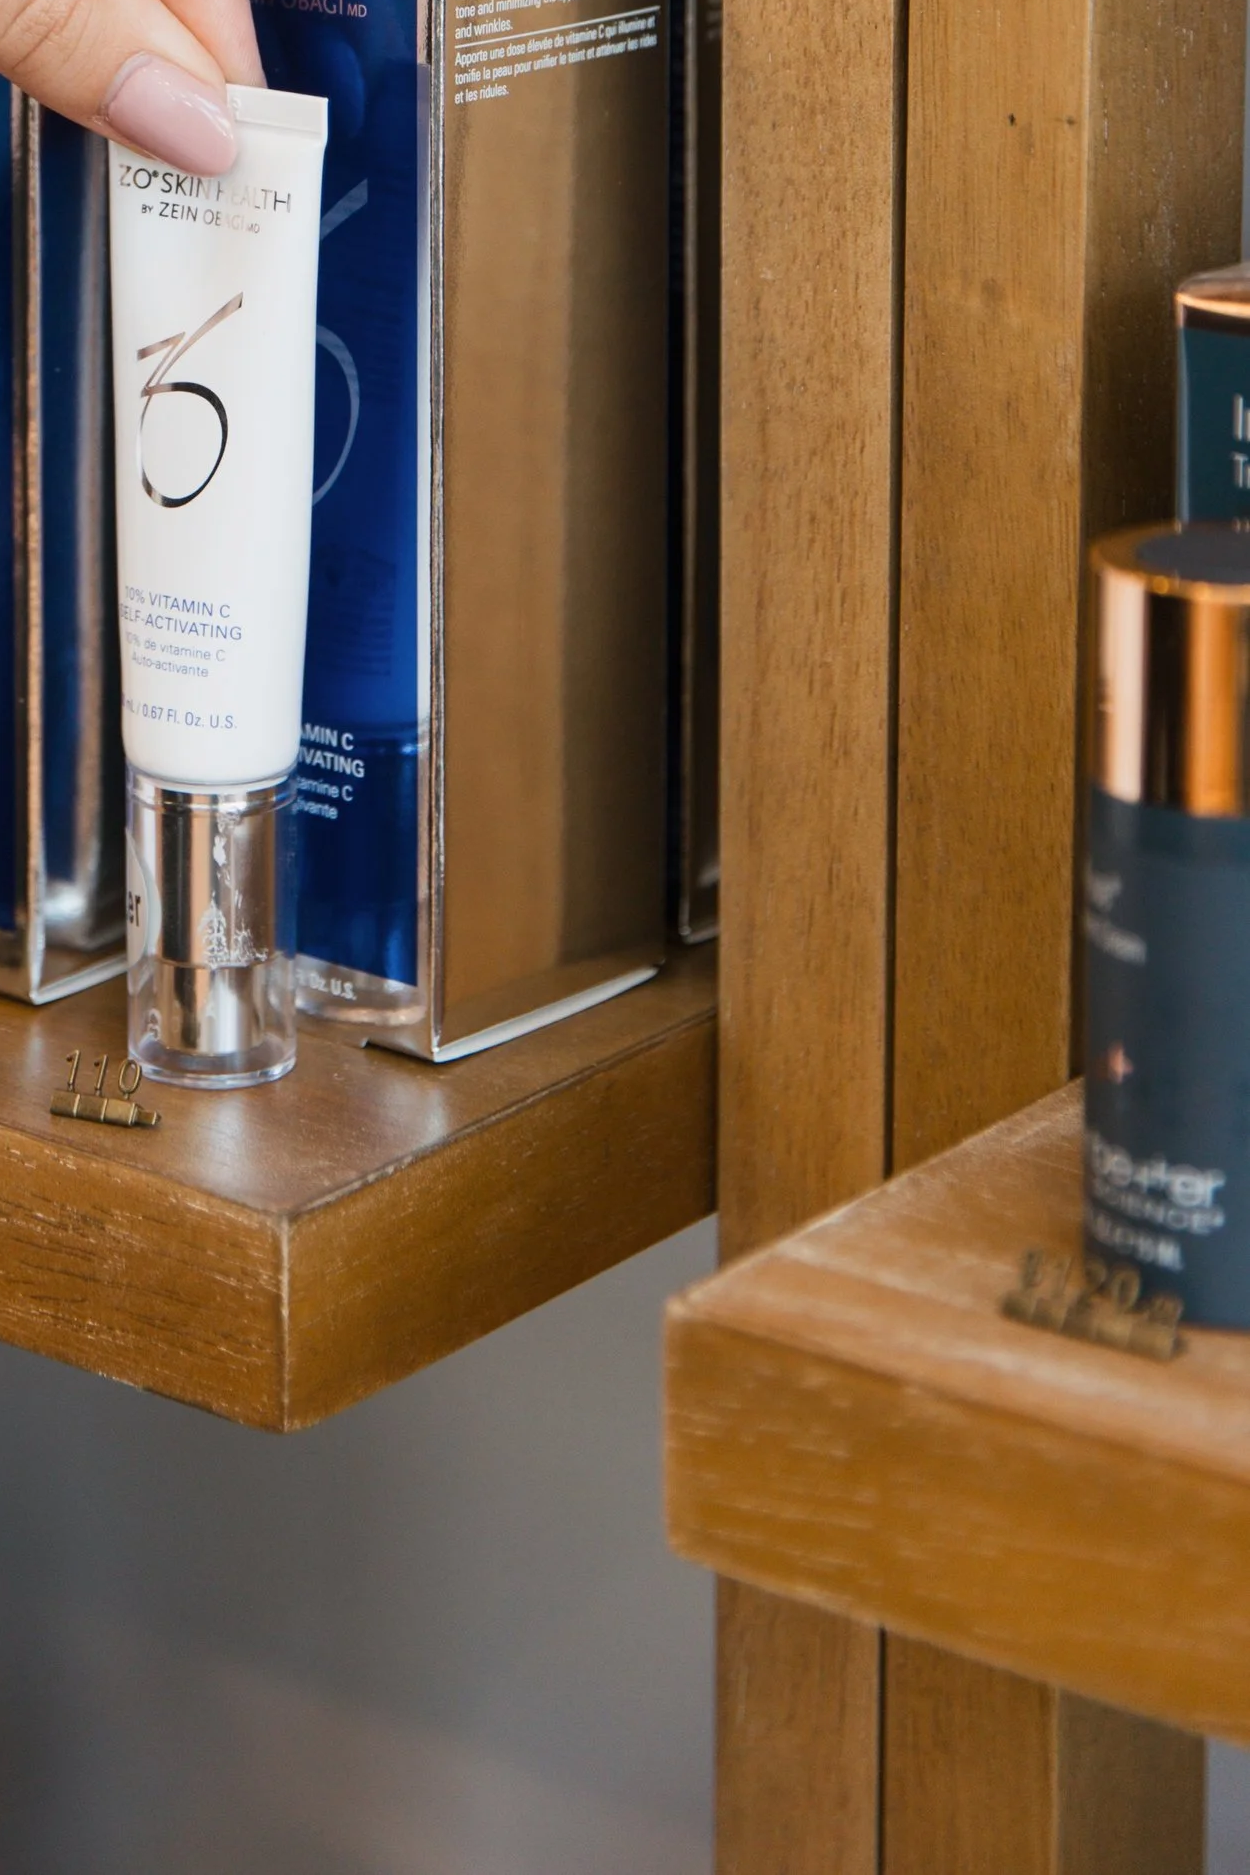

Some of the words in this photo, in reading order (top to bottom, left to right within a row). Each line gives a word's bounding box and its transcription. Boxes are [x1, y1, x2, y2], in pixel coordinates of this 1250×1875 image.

[347, 3, 368, 18] MD
[455, 6, 476, 19] tone
[455, 23, 472, 40] and
[474, 17, 513, 36] wrinkles.
[455, 49, 488, 68] Apporte
[489, 47, 505, 60] une
[506, 43, 526, 57] dose
[526, 36, 553, 53] élevée
[554, 33, 565, 48] de
[565, 27, 598, 45] vitamine
[598, 23, 605, 39] C
[455, 67, 481, 85] tonifie
[483, 66, 491, 80] la
[492, 64, 513, 81] peau
[514, 60, 532, 77] pour
[533, 54, 558, 71] unifier
[559, 51, 567, 65] le
[455, 89, 464, 105] et
[465, 87, 478, 102] les
[479, 82, 509, 100] ridules.
[160, 172, 210, 201] SKIN
[141, 204, 154, 215] BY
[158, 201, 199, 223] ZEIN
[149, 591, 214, 617] VITAMIN
[219, 604, 231, 619] C
[144, 638, 157, 651] de
[160, 643, 211, 661] vitamine
[215, 649, 226, 662] C
[132, 651, 209, 678] Auto-activante
[142, 703, 164, 720] 0.67
[184, 711, 205, 728] Oz.
[209, 715, 238, 730] U.S.
[341, 733, 354, 751] C
[342, 785, 354, 802] C
[66, 1049, 143, 1095] 110
